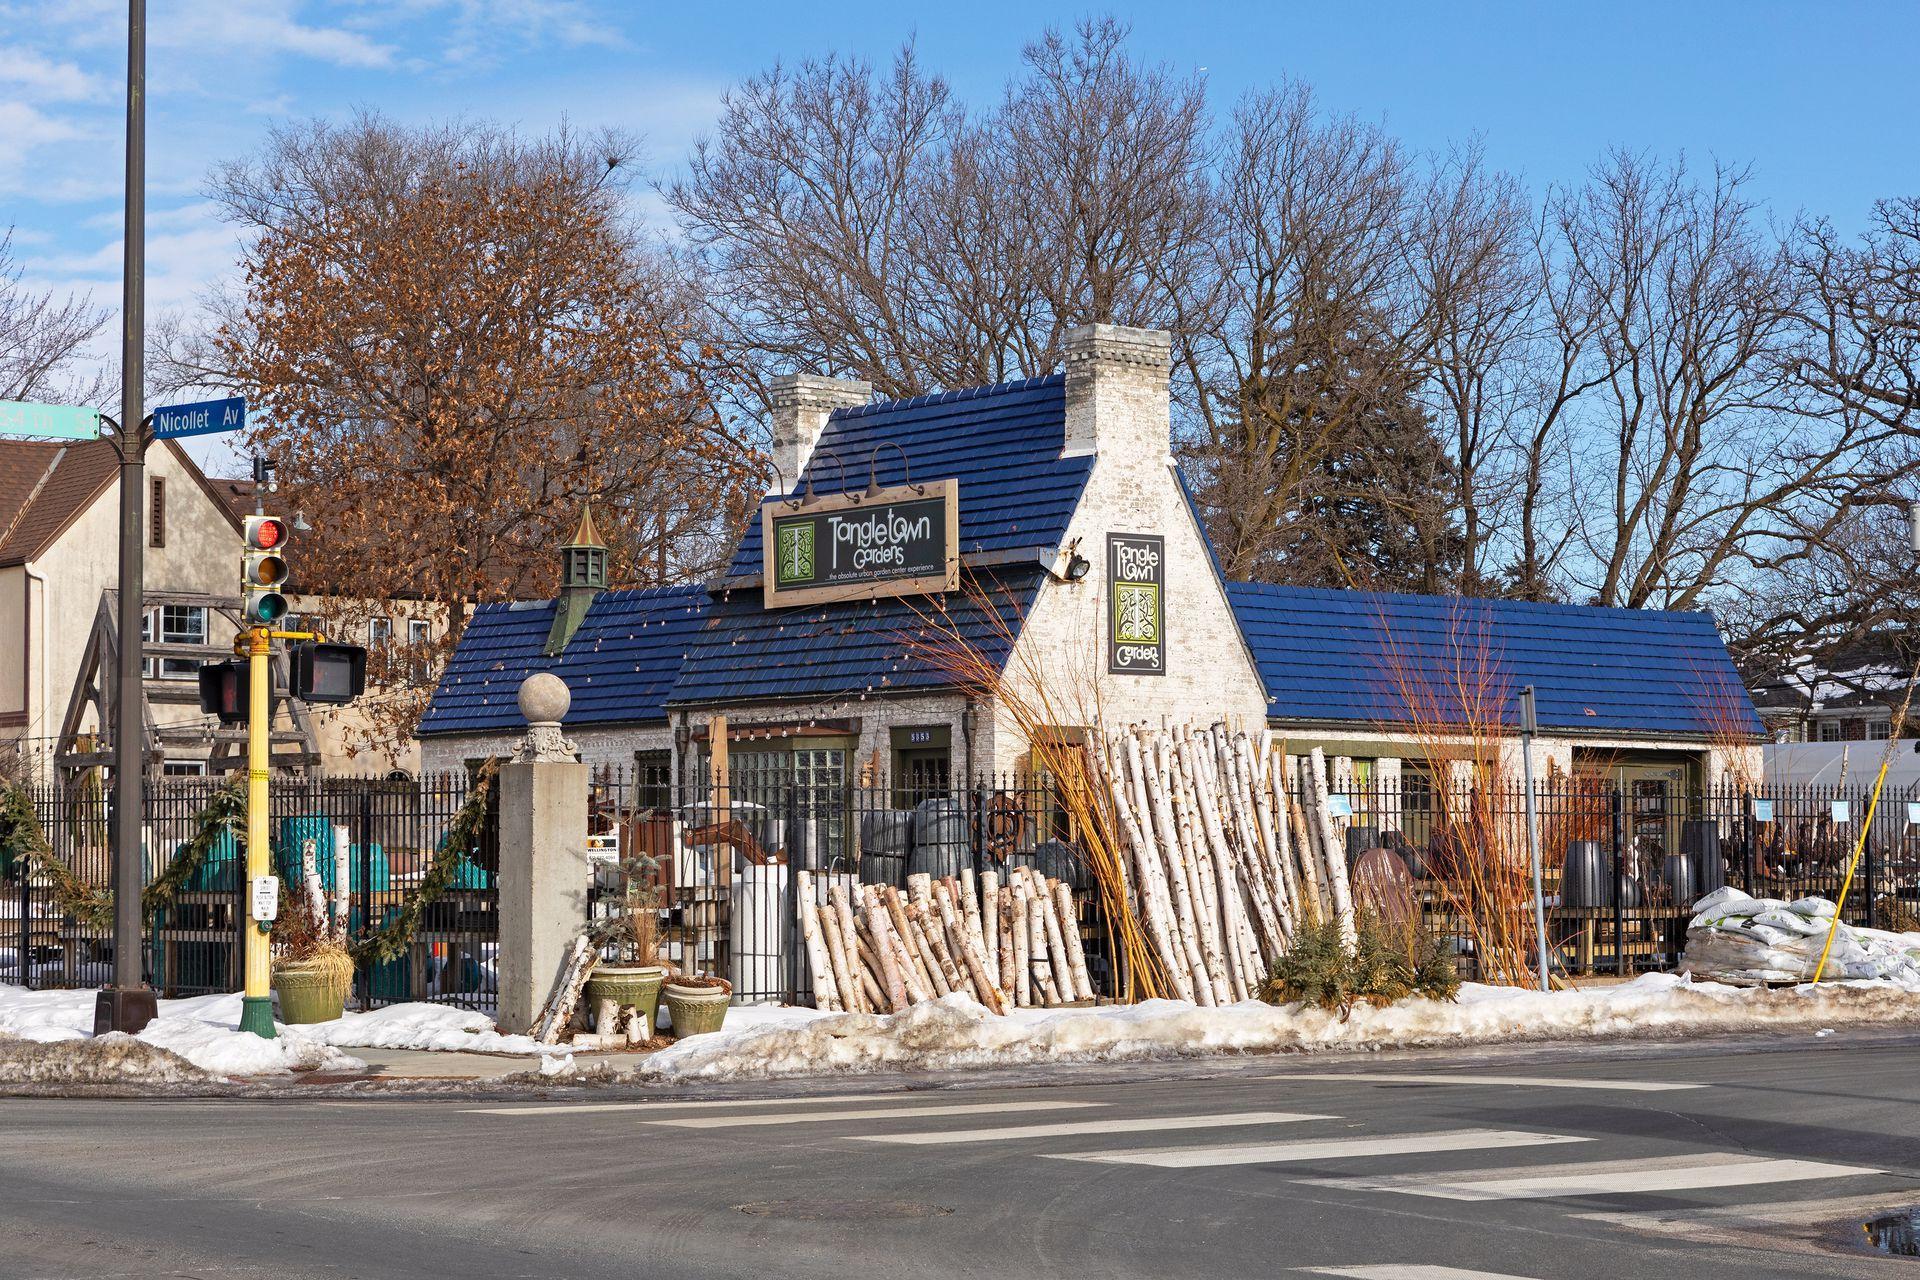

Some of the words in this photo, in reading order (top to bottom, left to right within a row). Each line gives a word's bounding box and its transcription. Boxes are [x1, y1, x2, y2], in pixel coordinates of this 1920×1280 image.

[160, 409, 209, 433] Nicollet
[222, 406, 239, 426] Av
[828, 508, 930, 569] Tangletown
[853, 544, 904, 569] Gardens
[1113, 541, 1159, 577] Tangle
[837, 570, 858, 580] absolute
[873, 568, 890, 578] garden
[892, 566, 907, 575] center
[907, 563, 934, 574] experience
[1116, 645, 1160, 668] Gardens
